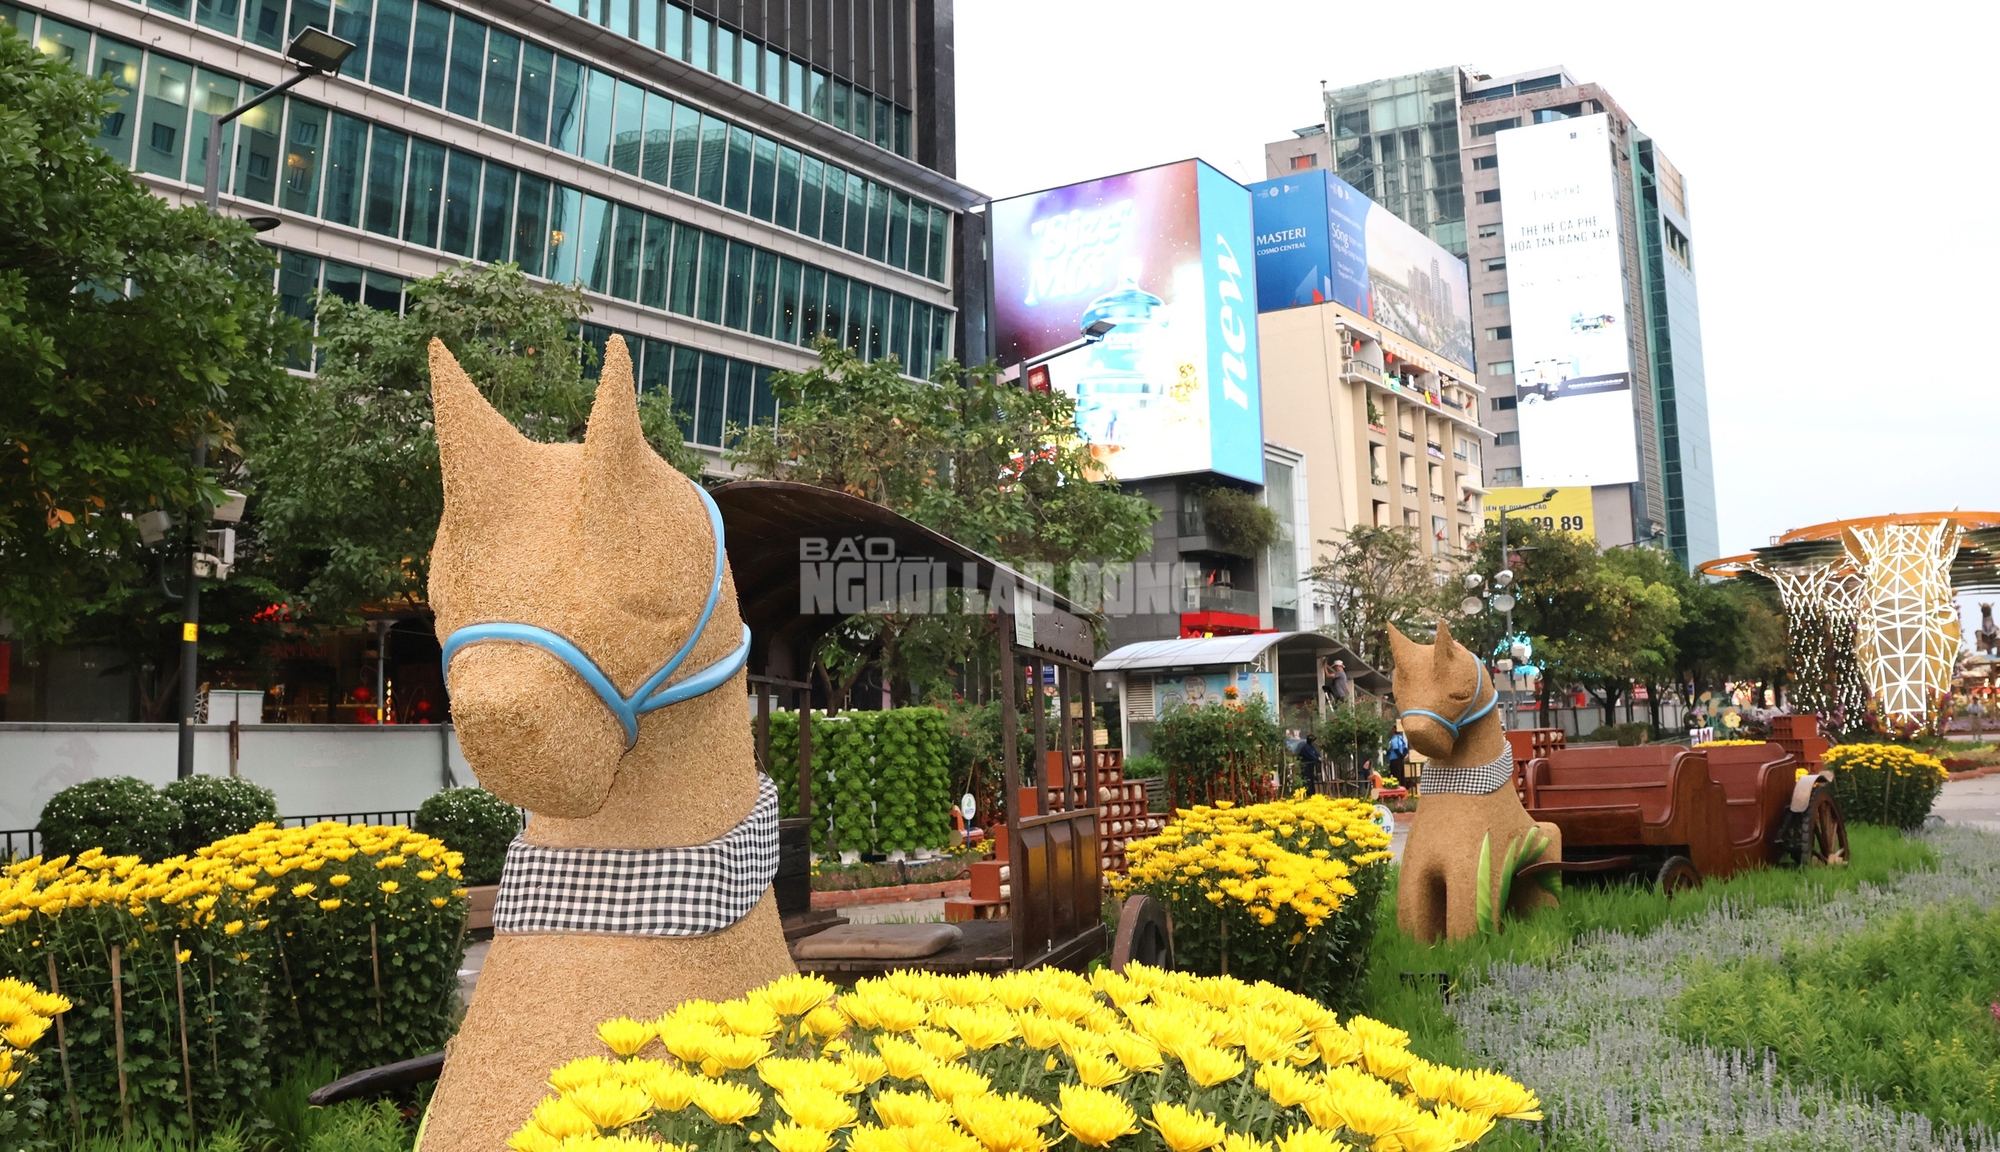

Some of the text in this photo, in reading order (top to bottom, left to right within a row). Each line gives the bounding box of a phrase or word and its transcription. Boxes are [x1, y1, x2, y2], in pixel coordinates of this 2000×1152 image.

[1256, 227, 1306, 246] MASTERI
[1257, 241, 1306, 256] COSMO CENTRAL
[1217, 233, 1248, 411] new
[1561, 515, 1583, 531] 89
